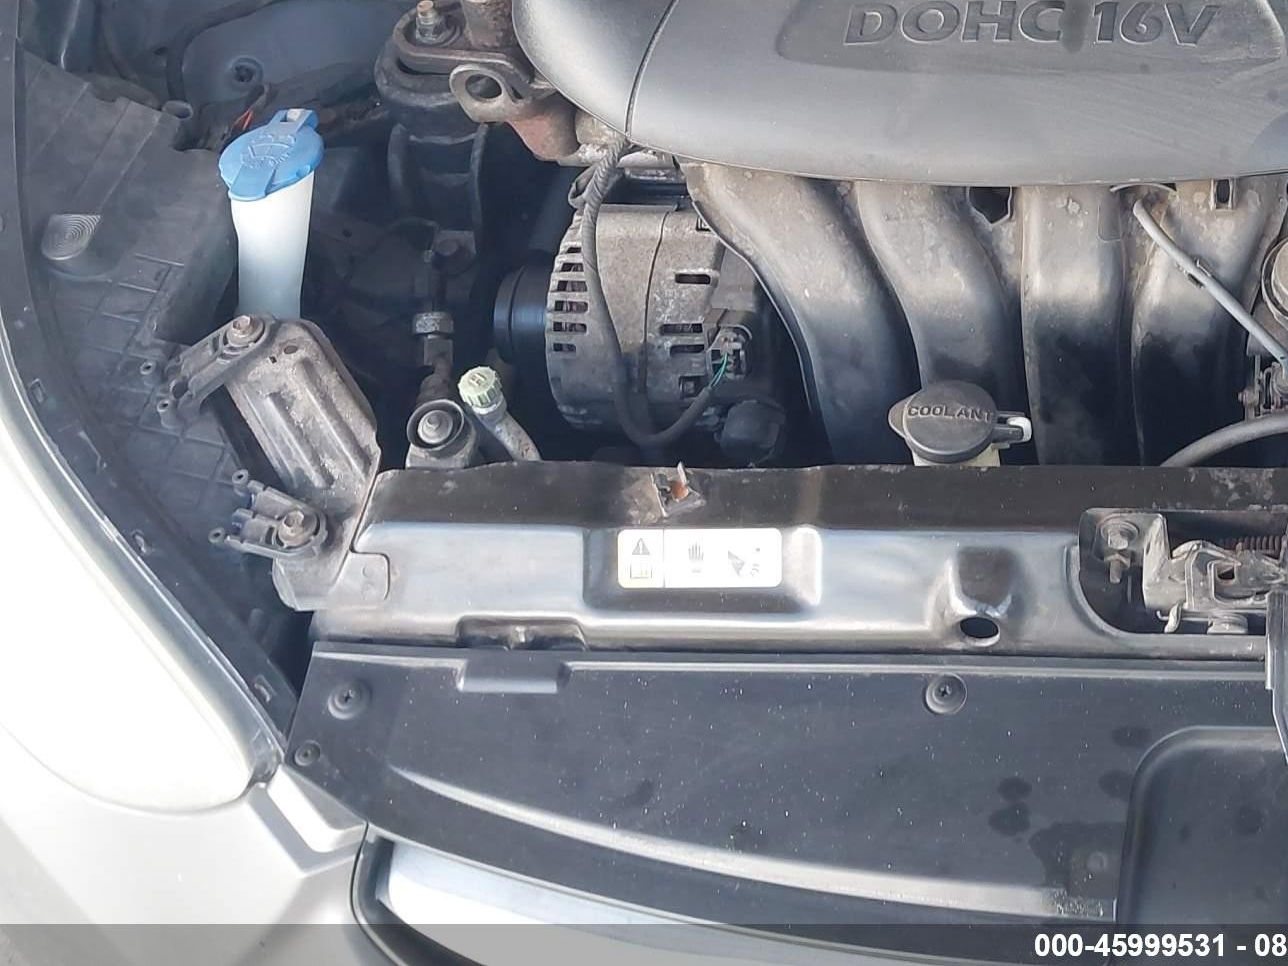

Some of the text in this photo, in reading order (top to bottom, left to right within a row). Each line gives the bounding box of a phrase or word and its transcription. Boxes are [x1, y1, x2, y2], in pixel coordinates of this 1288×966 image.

[842, 0, 1222, 46] DOHC 16V
[907, 405, 994, 425] COOLANT
